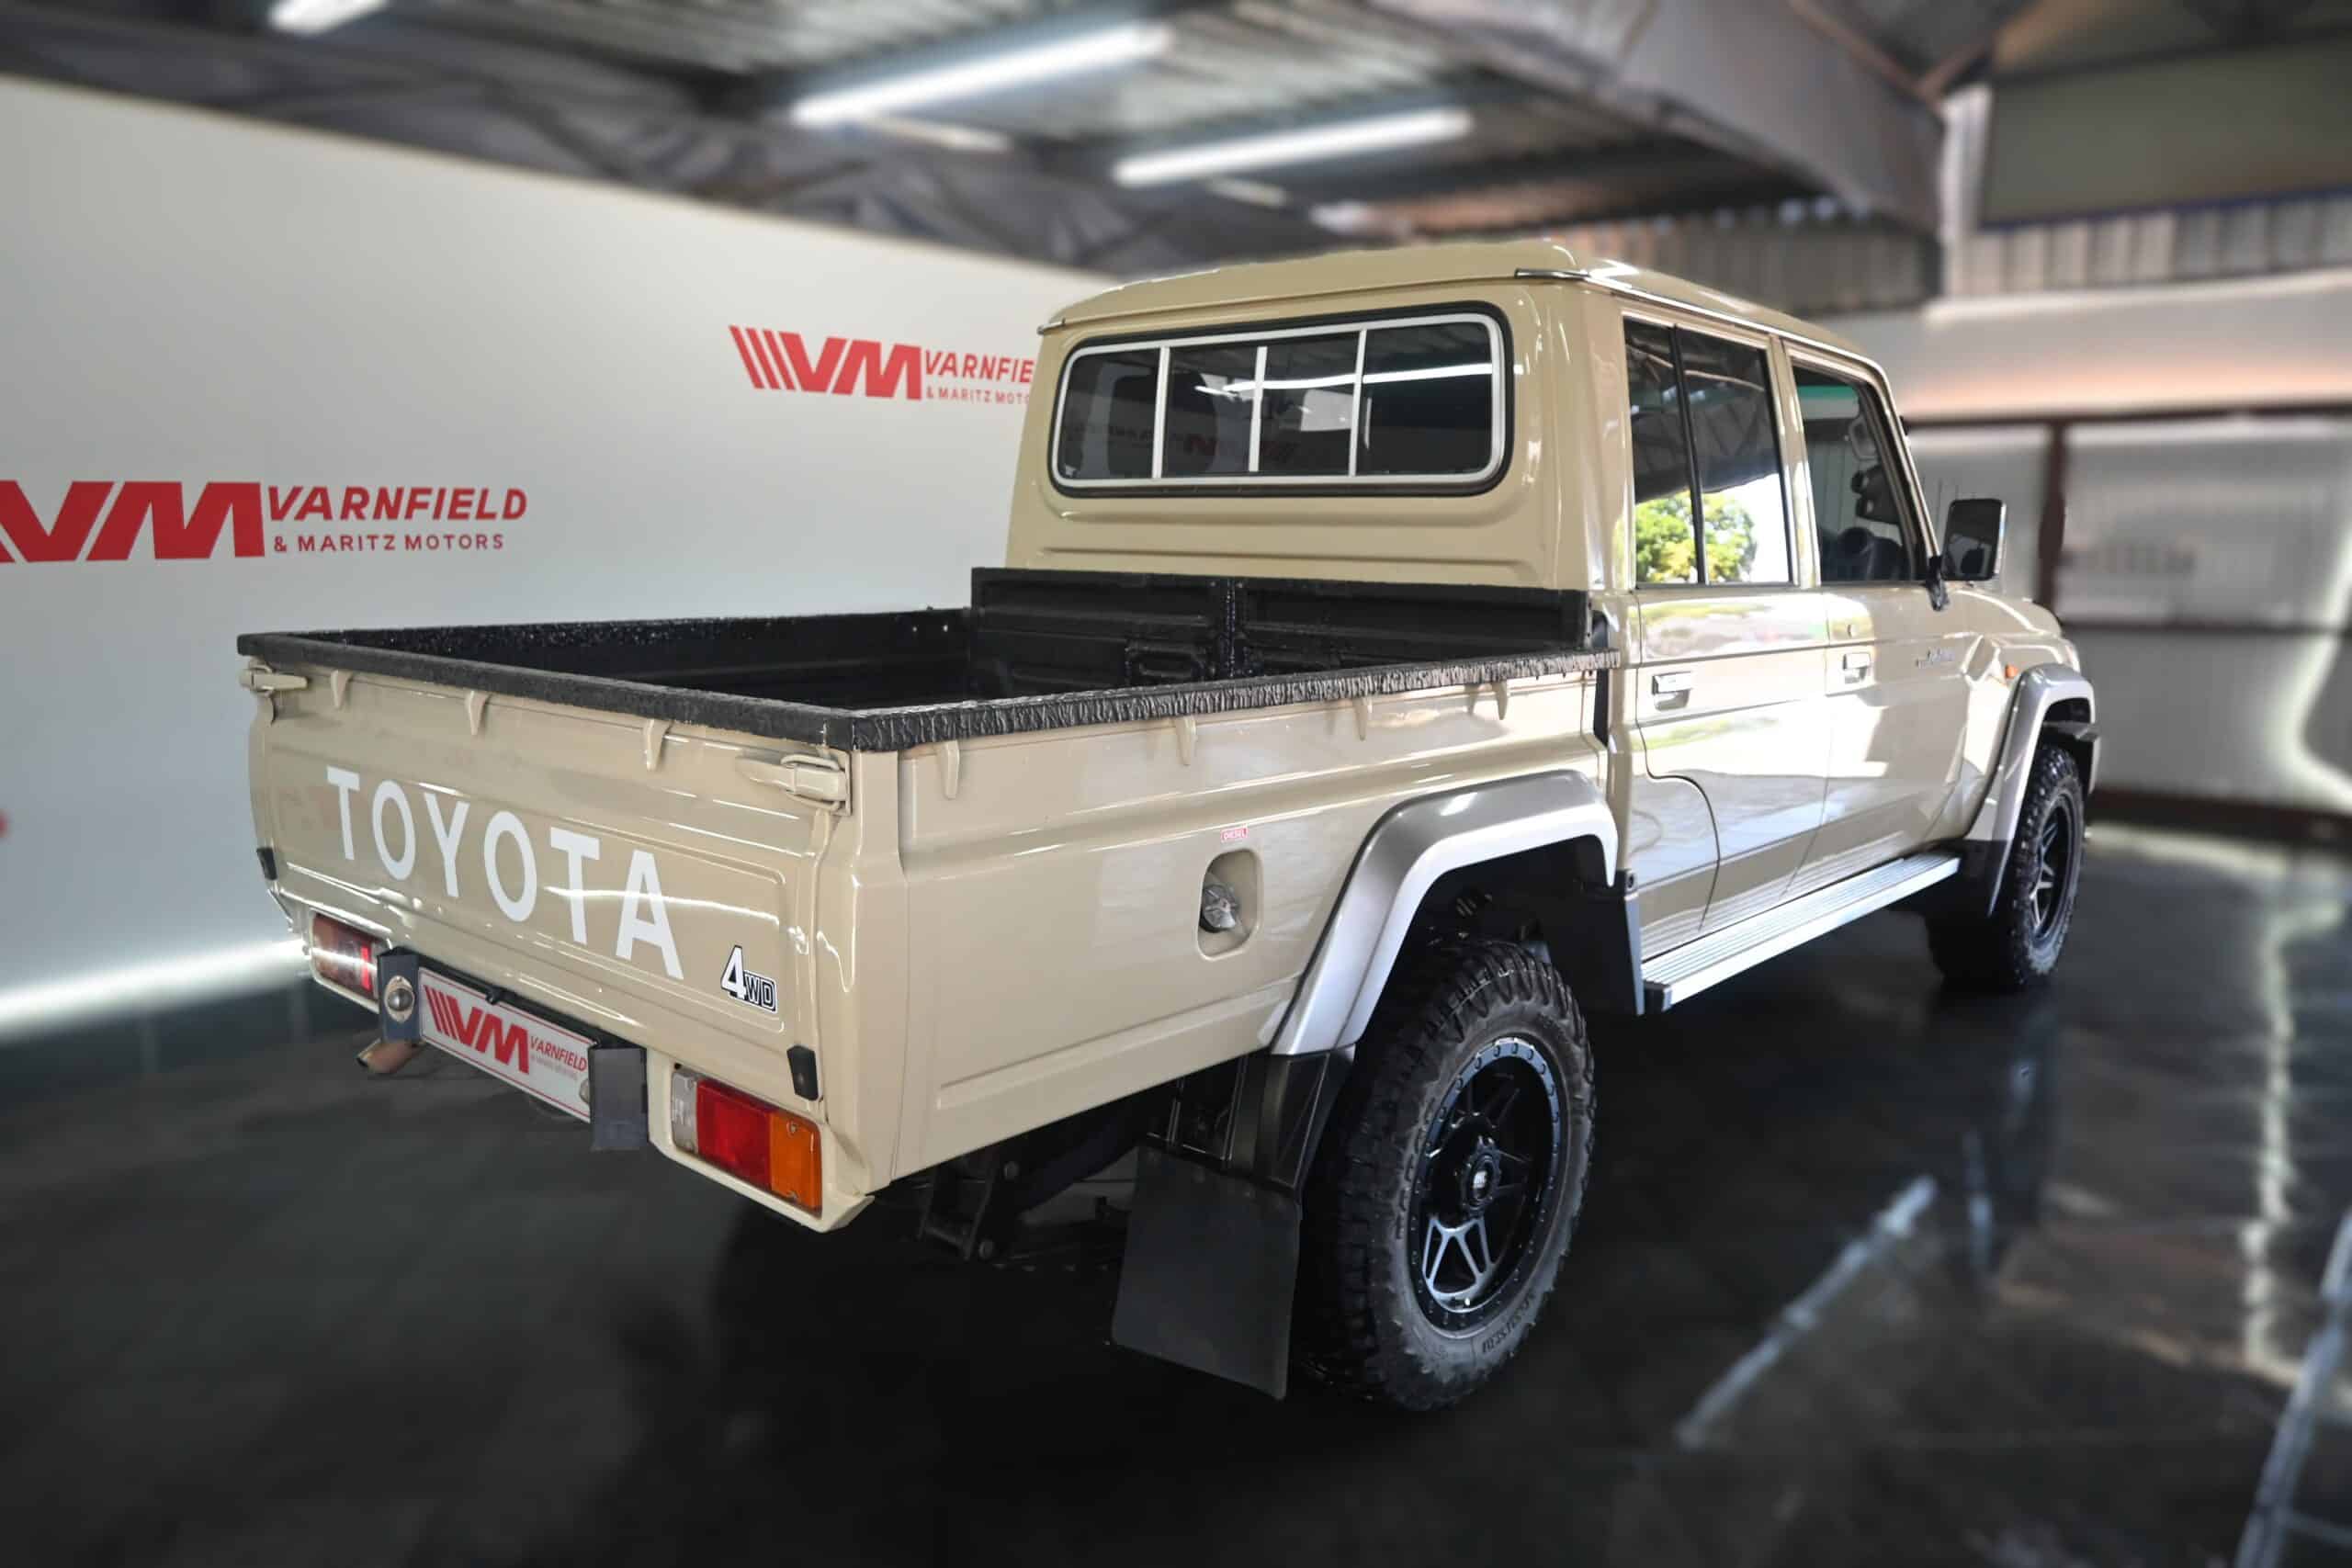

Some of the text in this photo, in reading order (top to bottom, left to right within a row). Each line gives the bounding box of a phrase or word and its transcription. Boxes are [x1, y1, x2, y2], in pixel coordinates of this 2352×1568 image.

[925, 349, 1035, 383] VARNFIE
[939, 387, 991, 403] MARITZ
[995, 390, 1028, 405] MOT
[268, 486, 527, 521] VARNFIELD
[274, 534, 504, 553] & MARITZ MOTORS
[326, 766, 684, 979] TOYOTA
[721, 945, 777, 1013] 4WD
[530, 1035, 588, 1072] VARNFIELD
